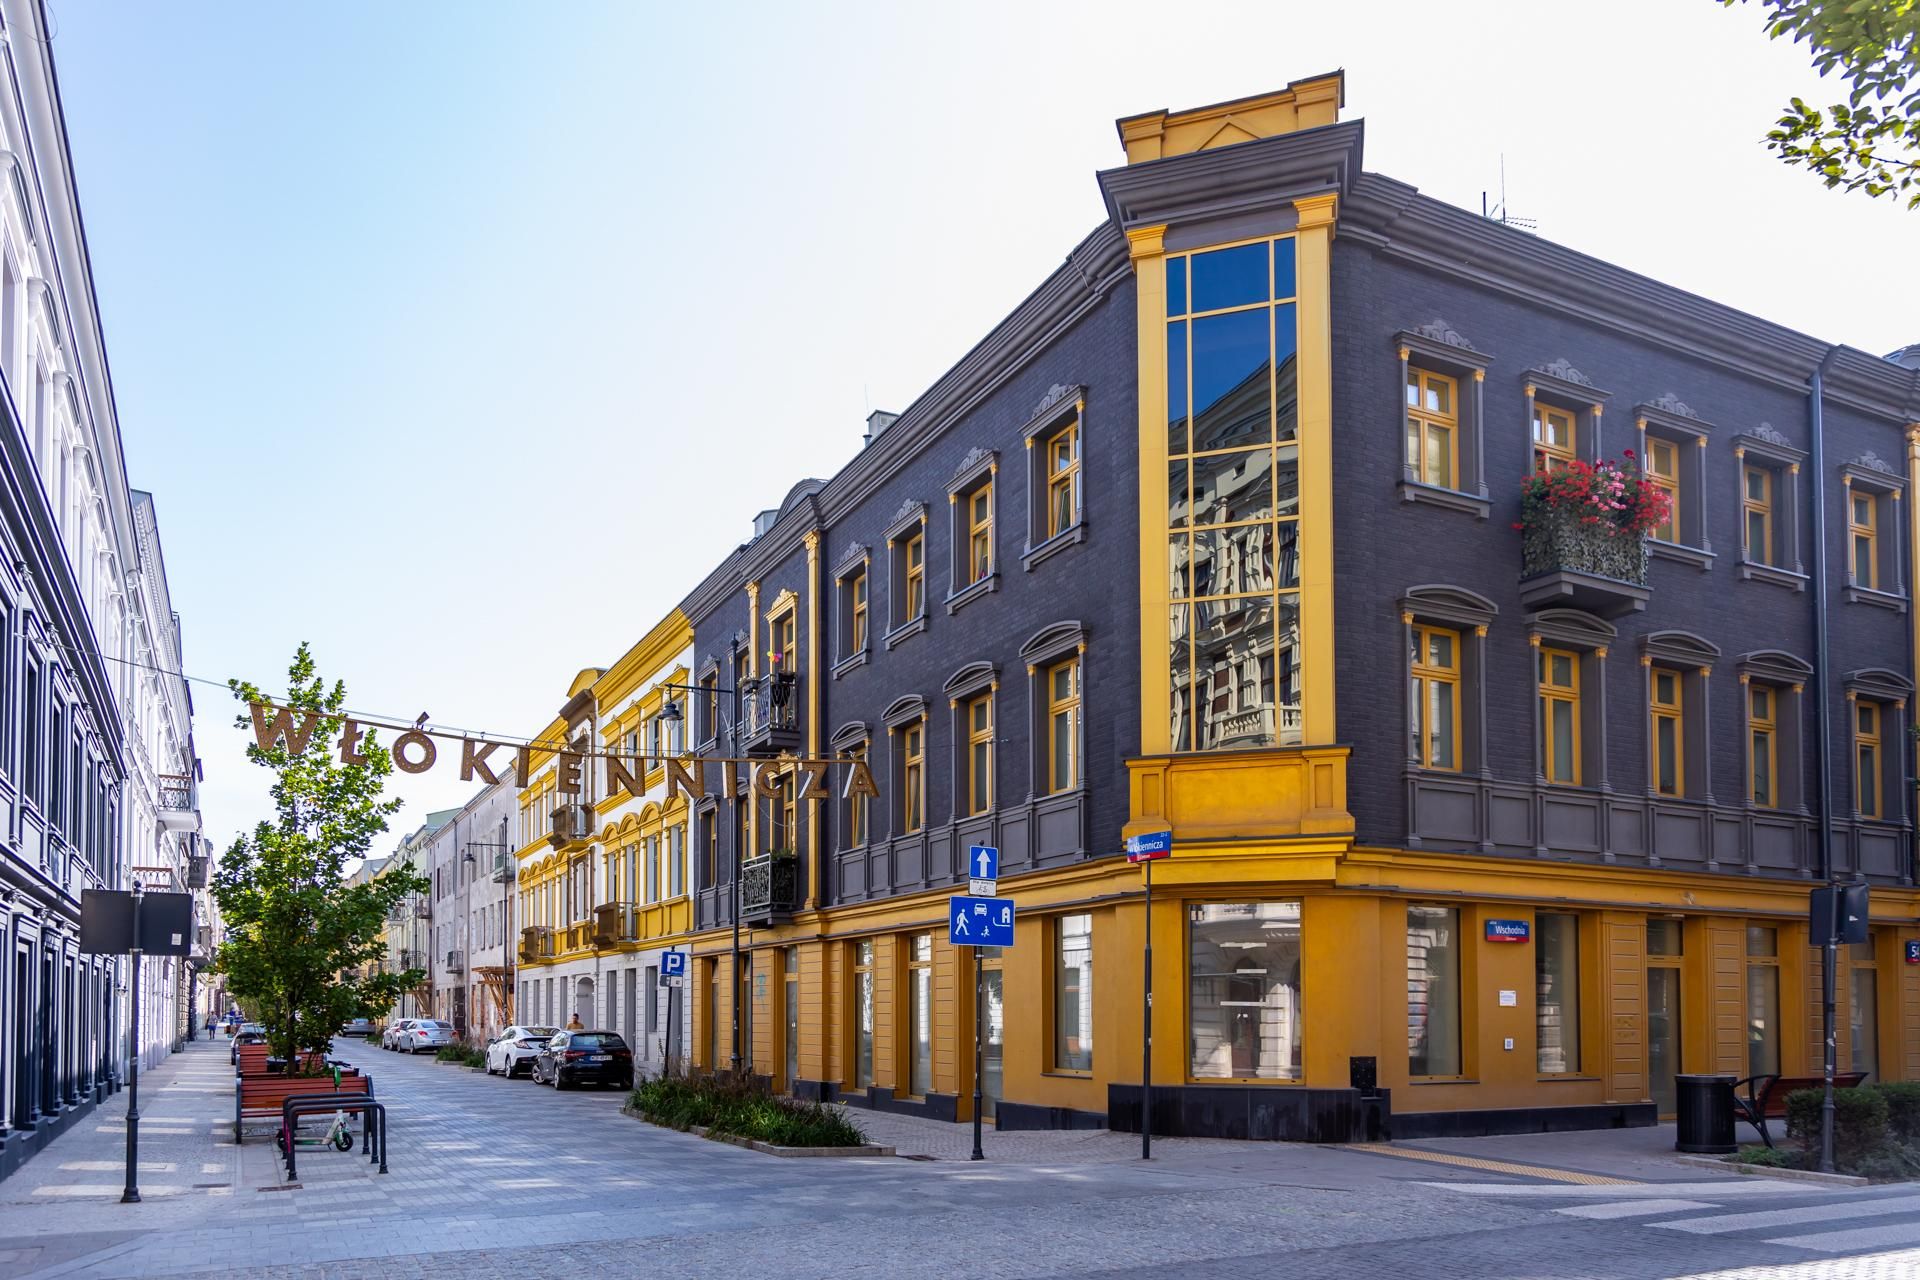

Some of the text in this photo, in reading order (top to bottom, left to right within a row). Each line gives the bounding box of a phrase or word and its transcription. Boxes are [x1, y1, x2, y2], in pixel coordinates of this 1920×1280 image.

[249, 702, 879, 799] WŁÓKIENNICZA
[1495, 925, 1525, 934] Wschodnia
[667, 954, 680, 972] P
